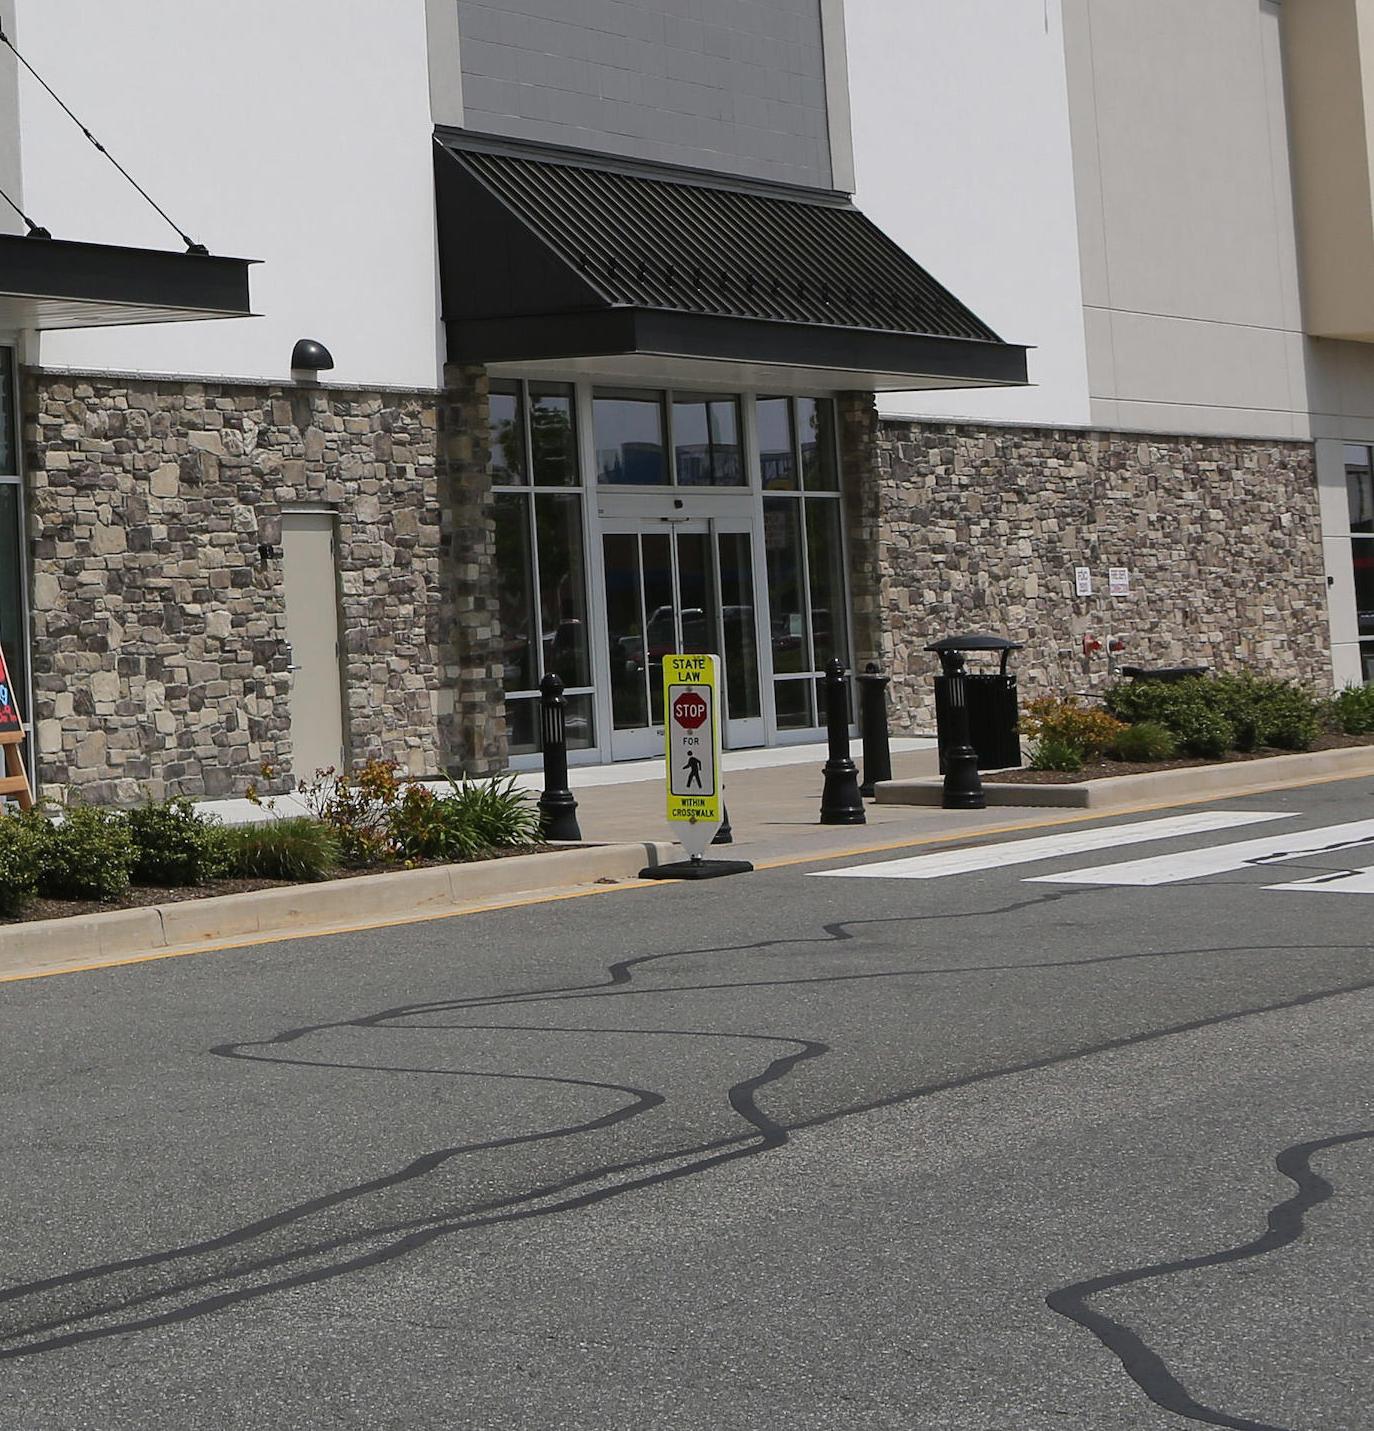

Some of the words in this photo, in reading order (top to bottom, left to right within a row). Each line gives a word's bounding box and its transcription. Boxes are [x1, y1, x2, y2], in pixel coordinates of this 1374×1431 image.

[673, 659, 705, 669] STATE
[678, 672, 700, 681] LAW
[676, 704, 705, 717] STOP
[683, 737, 699, 745] FOR
[673, 809, 714, 817] CROSSWALK
